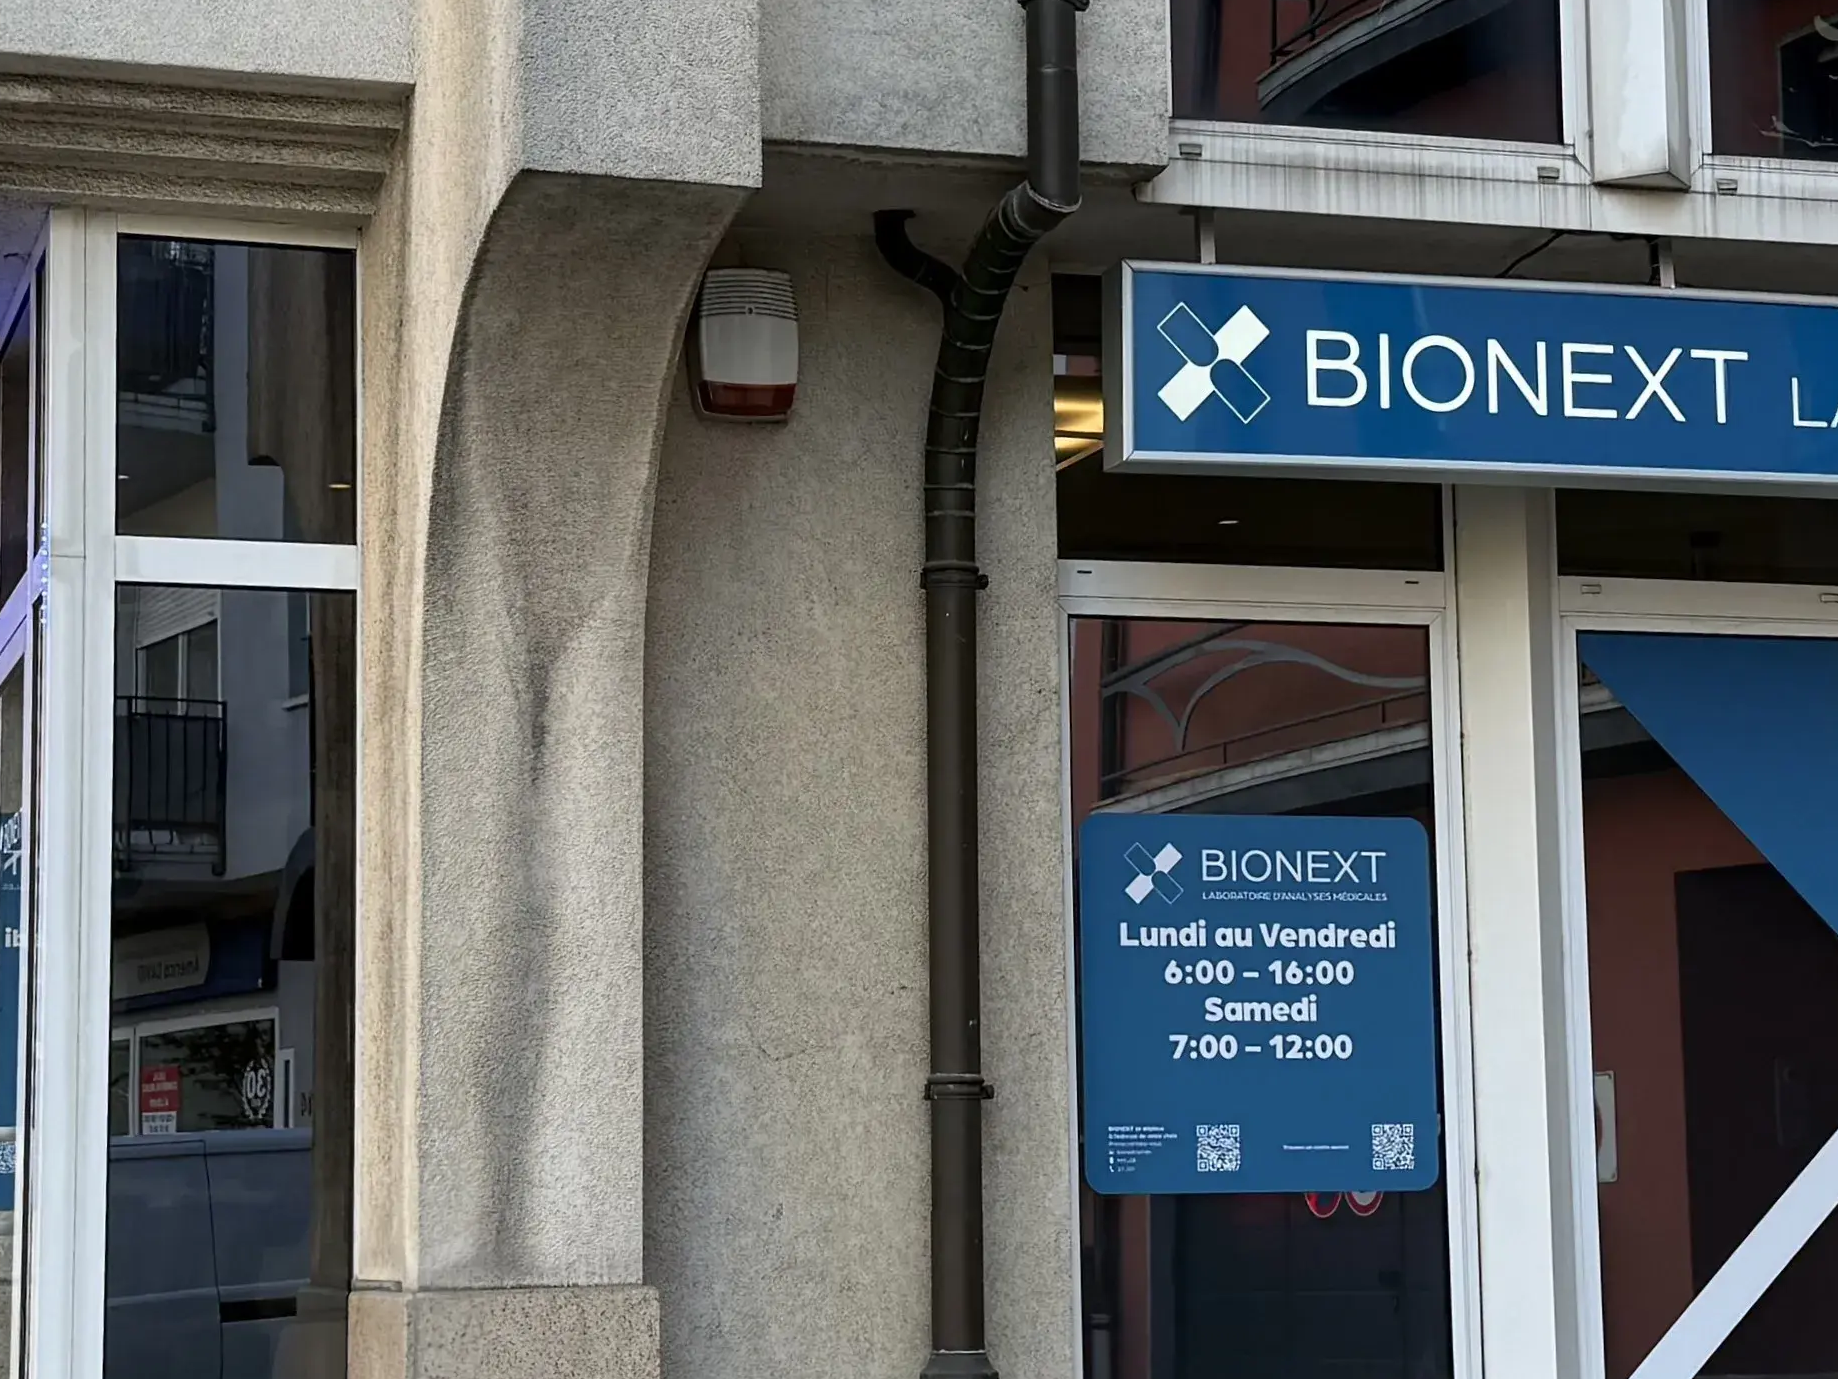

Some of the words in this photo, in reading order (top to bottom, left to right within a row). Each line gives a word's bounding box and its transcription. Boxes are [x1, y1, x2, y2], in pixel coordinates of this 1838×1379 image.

[1305, 328, 1749, 425] BIONEXT
[1200, 849, 1387, 884] BIONEXT
[1202, 891, 1271, 900] LABORATOIRE
[1120, 919, 1207, 948] Lundi
[1214, 927, 1253, 948] au
[1259, 920, 1396, 949] Vendredi
[1164, 959, 1235, 985] 6:00
[1268, 959, 1355, 985] 16:00
[1204, 995, 1318, 1023] Samedi
[1168, 1033, 1238, 1060] 7:00
[1268, 1033, 1353, 1060] 12:00
